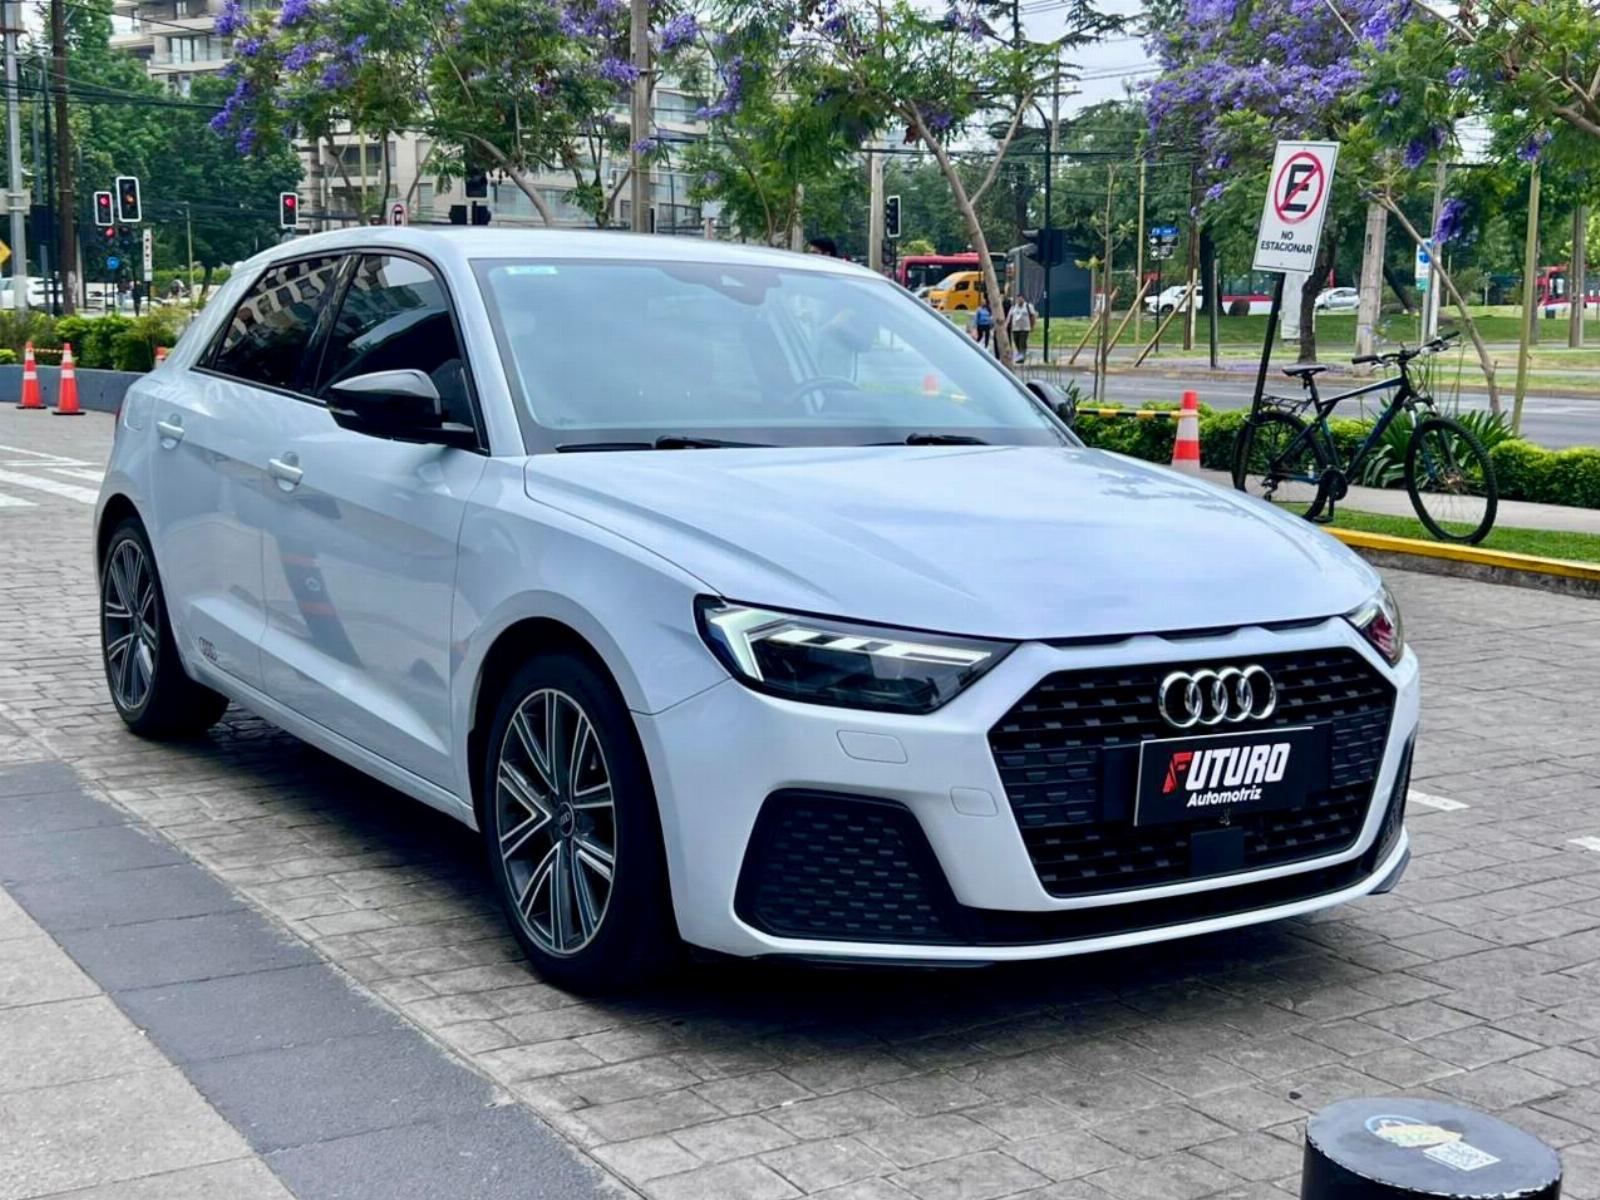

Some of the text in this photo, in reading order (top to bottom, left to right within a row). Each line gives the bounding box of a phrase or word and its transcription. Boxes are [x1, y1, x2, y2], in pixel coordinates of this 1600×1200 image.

[1281, 231, 1294, 241] NO
[1260, 240, 1313, 254] ESTACIONAR
[1163, 743, 1291, 793] FUTURO
[1186, 784, 1262, 808] Automotriz
